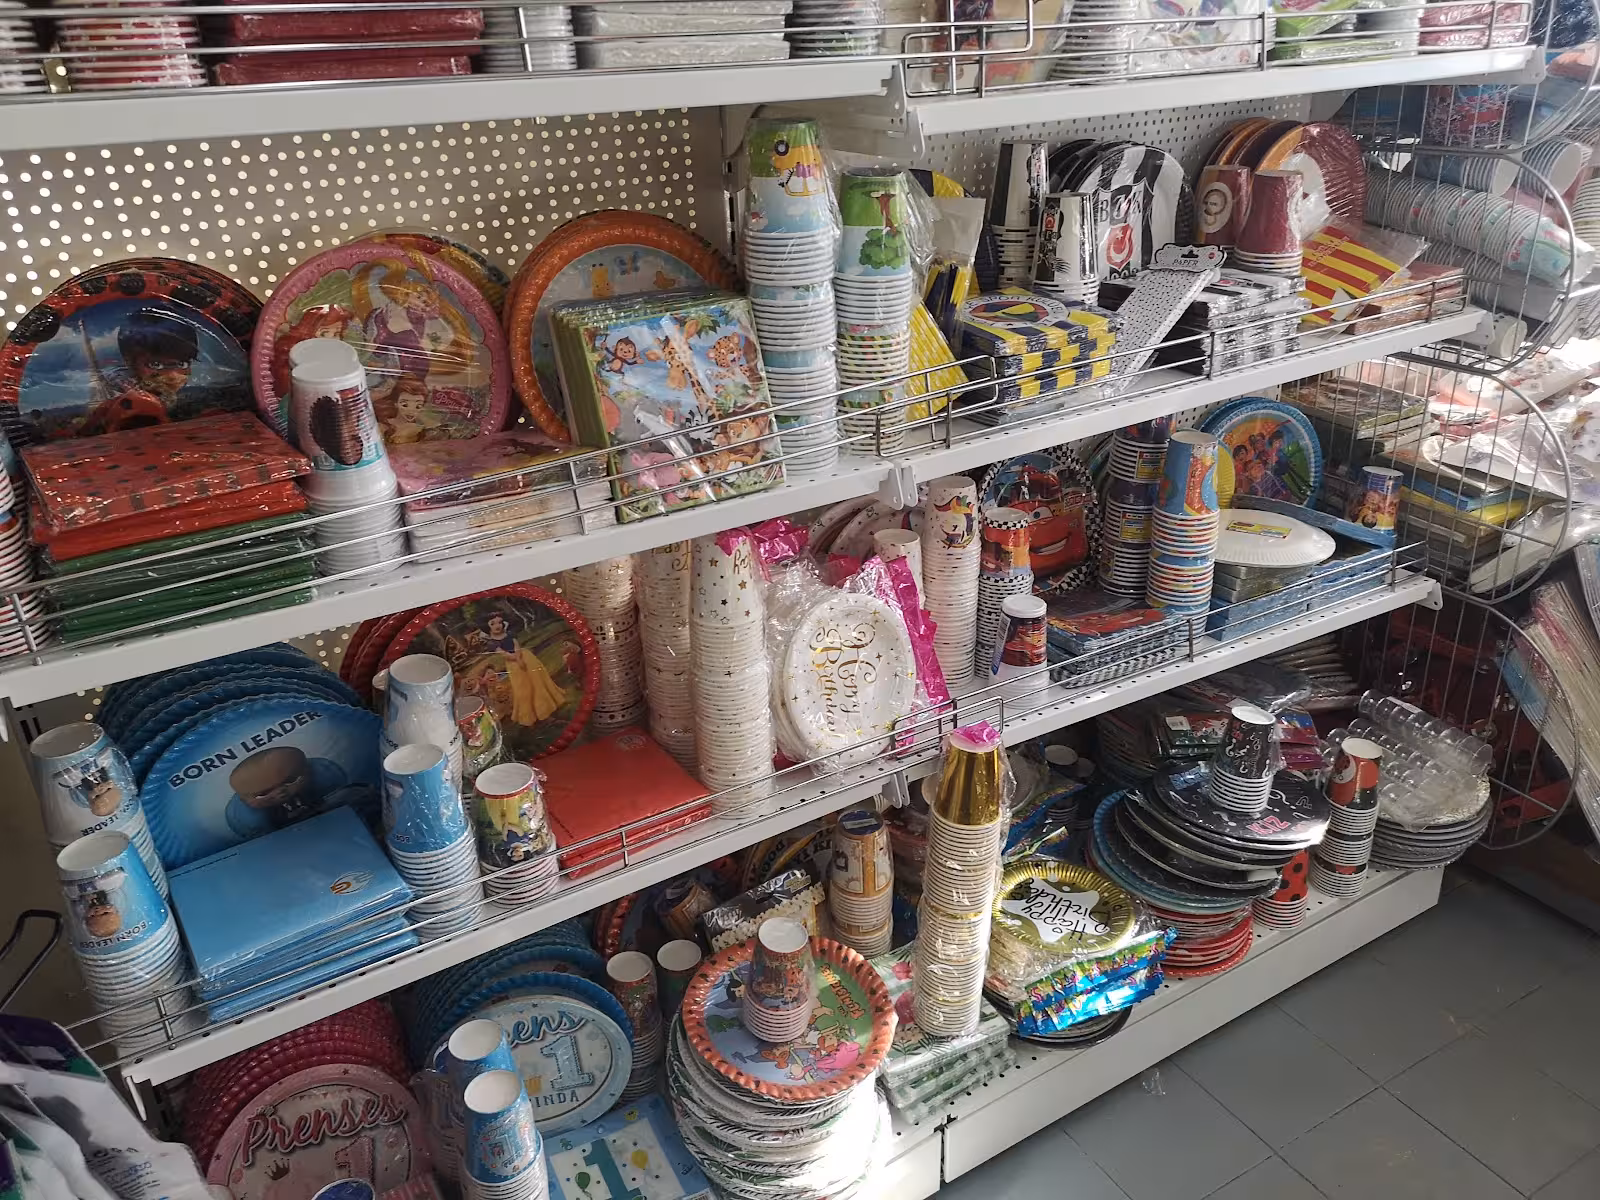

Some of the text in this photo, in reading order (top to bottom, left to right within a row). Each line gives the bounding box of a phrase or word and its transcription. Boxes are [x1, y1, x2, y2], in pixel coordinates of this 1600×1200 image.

[168, 710, 323, 788] BORN LEADER
[115, 920, 148, 943] BORN
[1021, 901, 1088, 941] Happy
[507, 1009, 588, 1047] ens
[540, 1034, 594, 1090] 1
[242, 1093, 407, 1167] Prenses
